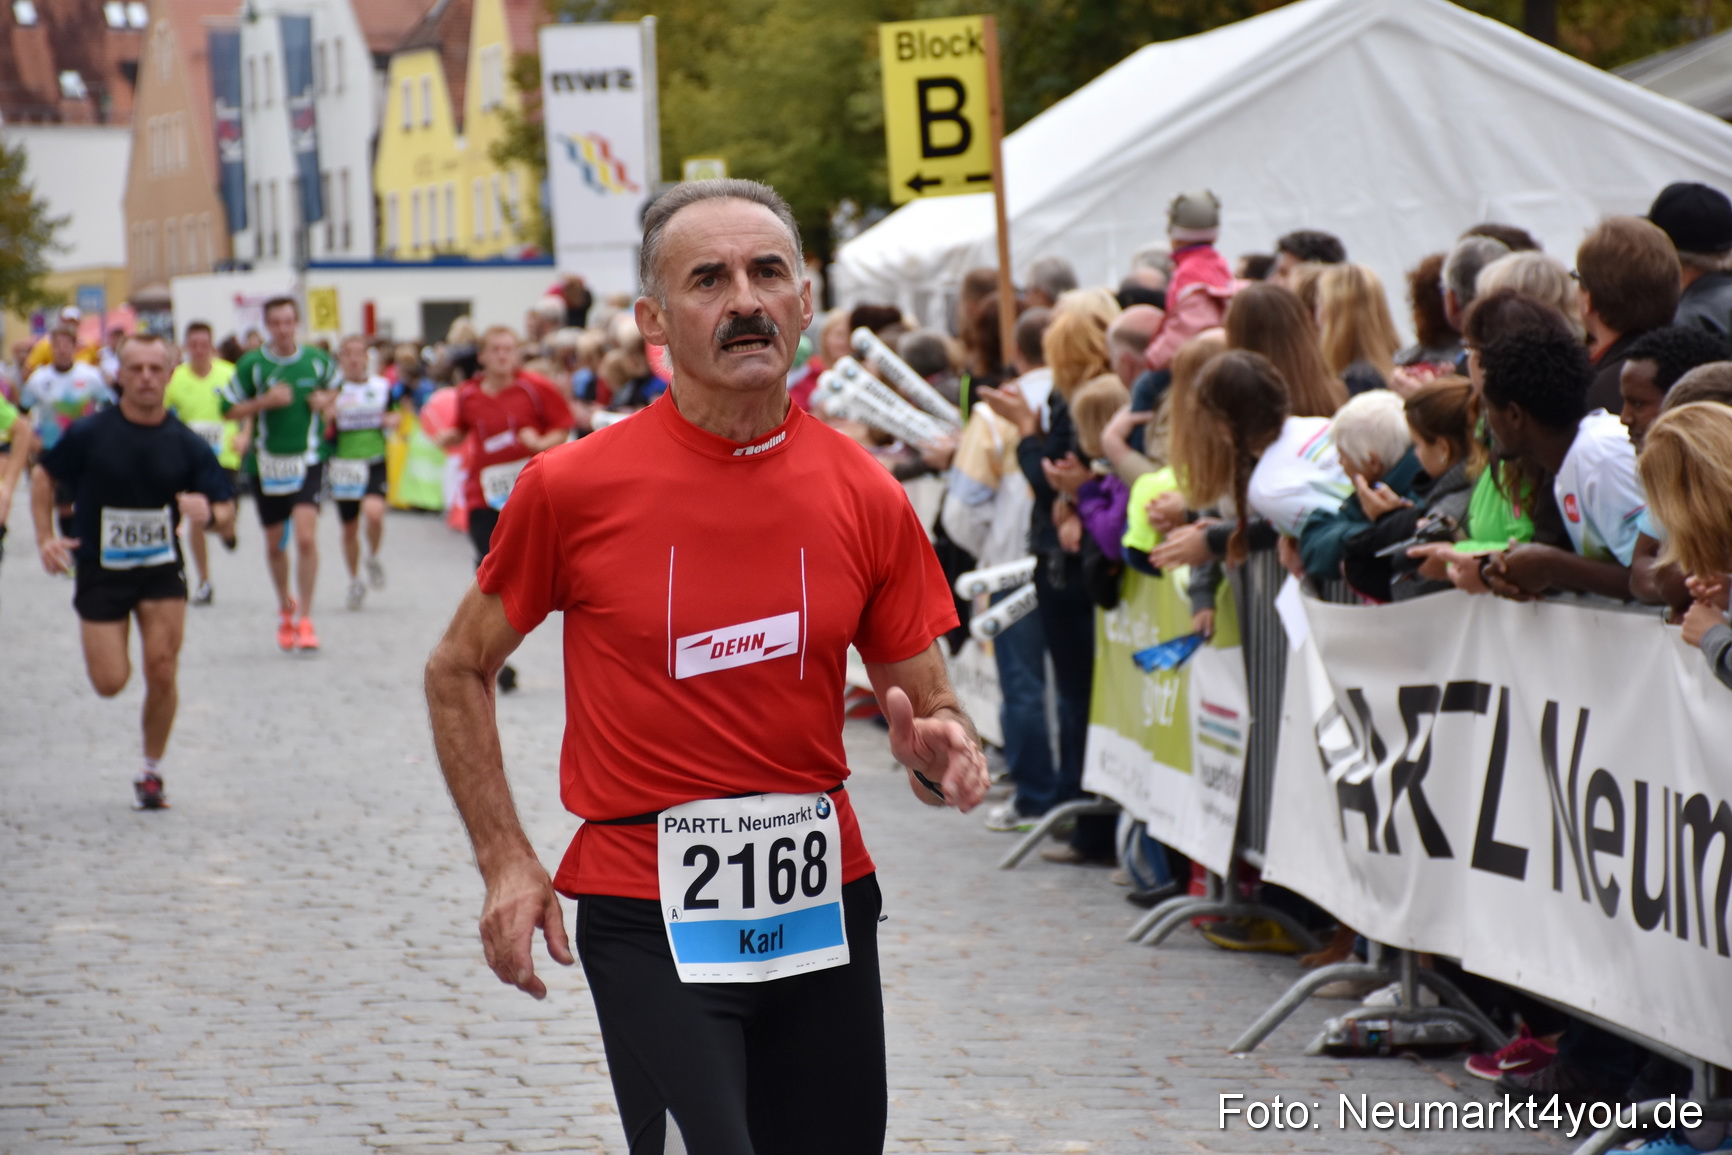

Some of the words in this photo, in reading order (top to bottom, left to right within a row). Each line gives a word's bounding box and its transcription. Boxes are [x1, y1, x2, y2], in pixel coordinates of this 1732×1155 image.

[896, 25, 985, 62] Block
[917, 77, 973, 159] B
[110, 524, 166, 547] 2654
[710, 631, 766, 660] DEHN
[664, 817, 733, 833] PARTL
[738, 805, 813, 832] Neumarkt
[682, 830, 828, 911] 2168
[671, 908, 679, 920] A
[739, 923, 784, 955] Karl
